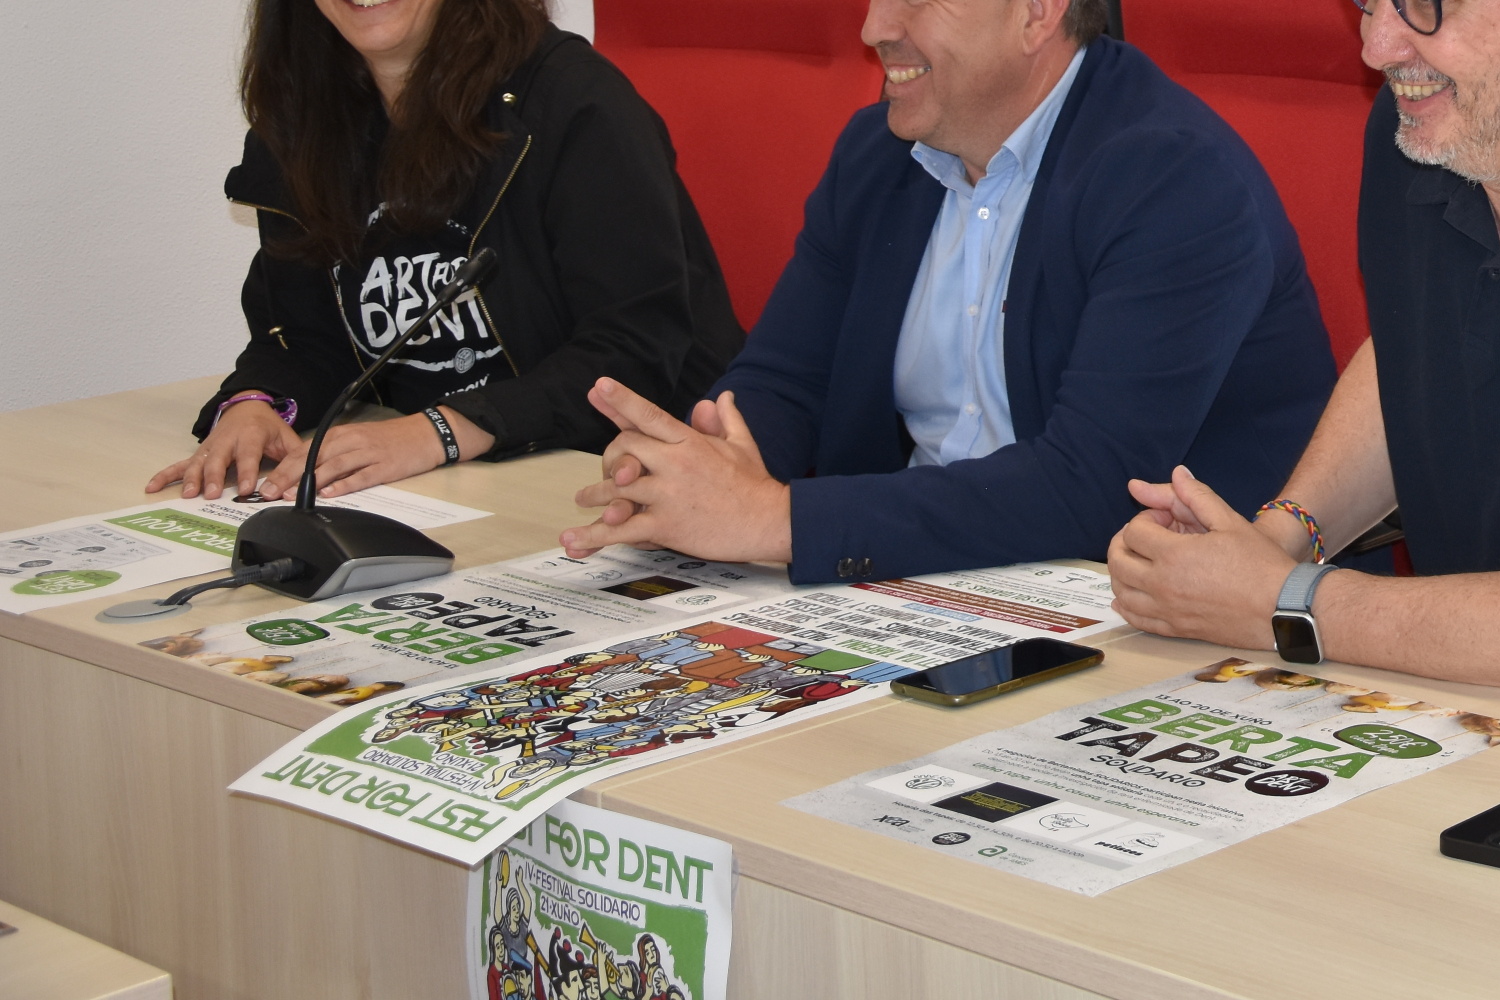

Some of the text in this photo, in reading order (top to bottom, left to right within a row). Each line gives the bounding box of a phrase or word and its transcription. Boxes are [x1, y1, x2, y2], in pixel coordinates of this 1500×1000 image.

[360, 252, 440, 307] ART
[360, 288, 488, 348] DENT
[473, 596, 556, 619] SOLIDARIO
[313, 602, 524, 664] BERTA
[1155, 694, 1274, 727] 13 AO 20 DE XUÑO
[1098, 699, 1379, 779] BERTA
[262, 755, 361, 795] DENT
[362, 749, 424, 772] SOLIDARIO
[1090, 753, 1206, 788] SOLIDARIO
[1270, 772, 1300, 786] ART
[342, 776, 432, 817] FOR
[1262, 778, 1312, 794] DENT
[408, 799, 507, 842] FEST
[545, 813, 714, 903] FOR DENT
[577, 888, 641, 921] SOLIDARIO
